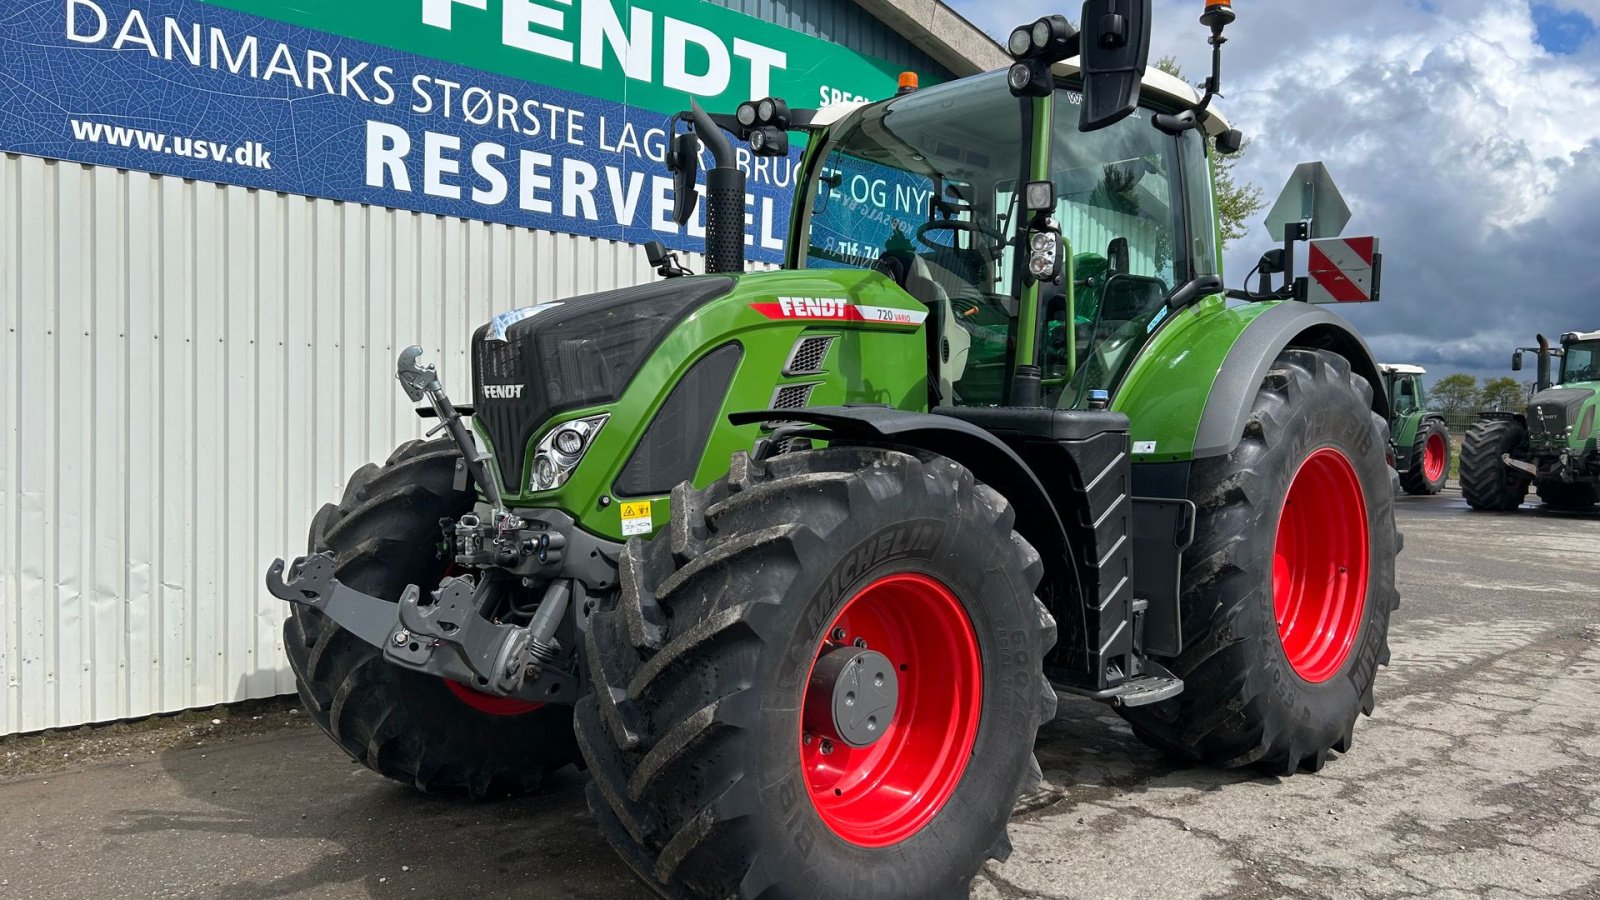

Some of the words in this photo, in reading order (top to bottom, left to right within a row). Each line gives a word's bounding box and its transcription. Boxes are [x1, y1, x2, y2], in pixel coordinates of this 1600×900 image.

[65, 0, 395, 105] DANMARKS
[412, 74, 584, 146] STØRSTE
[600, 116, 706, 171] LAGR
[70, 119, 272, 170] www.usv.dk
[851, 174, 887, 208] OG
[778, 296, 848, 317] FENDT
[877, 309, 893, 321] 720
[483, 383, 525, 399] FENDT
[807, 524, 944, 636] MICHELIN
